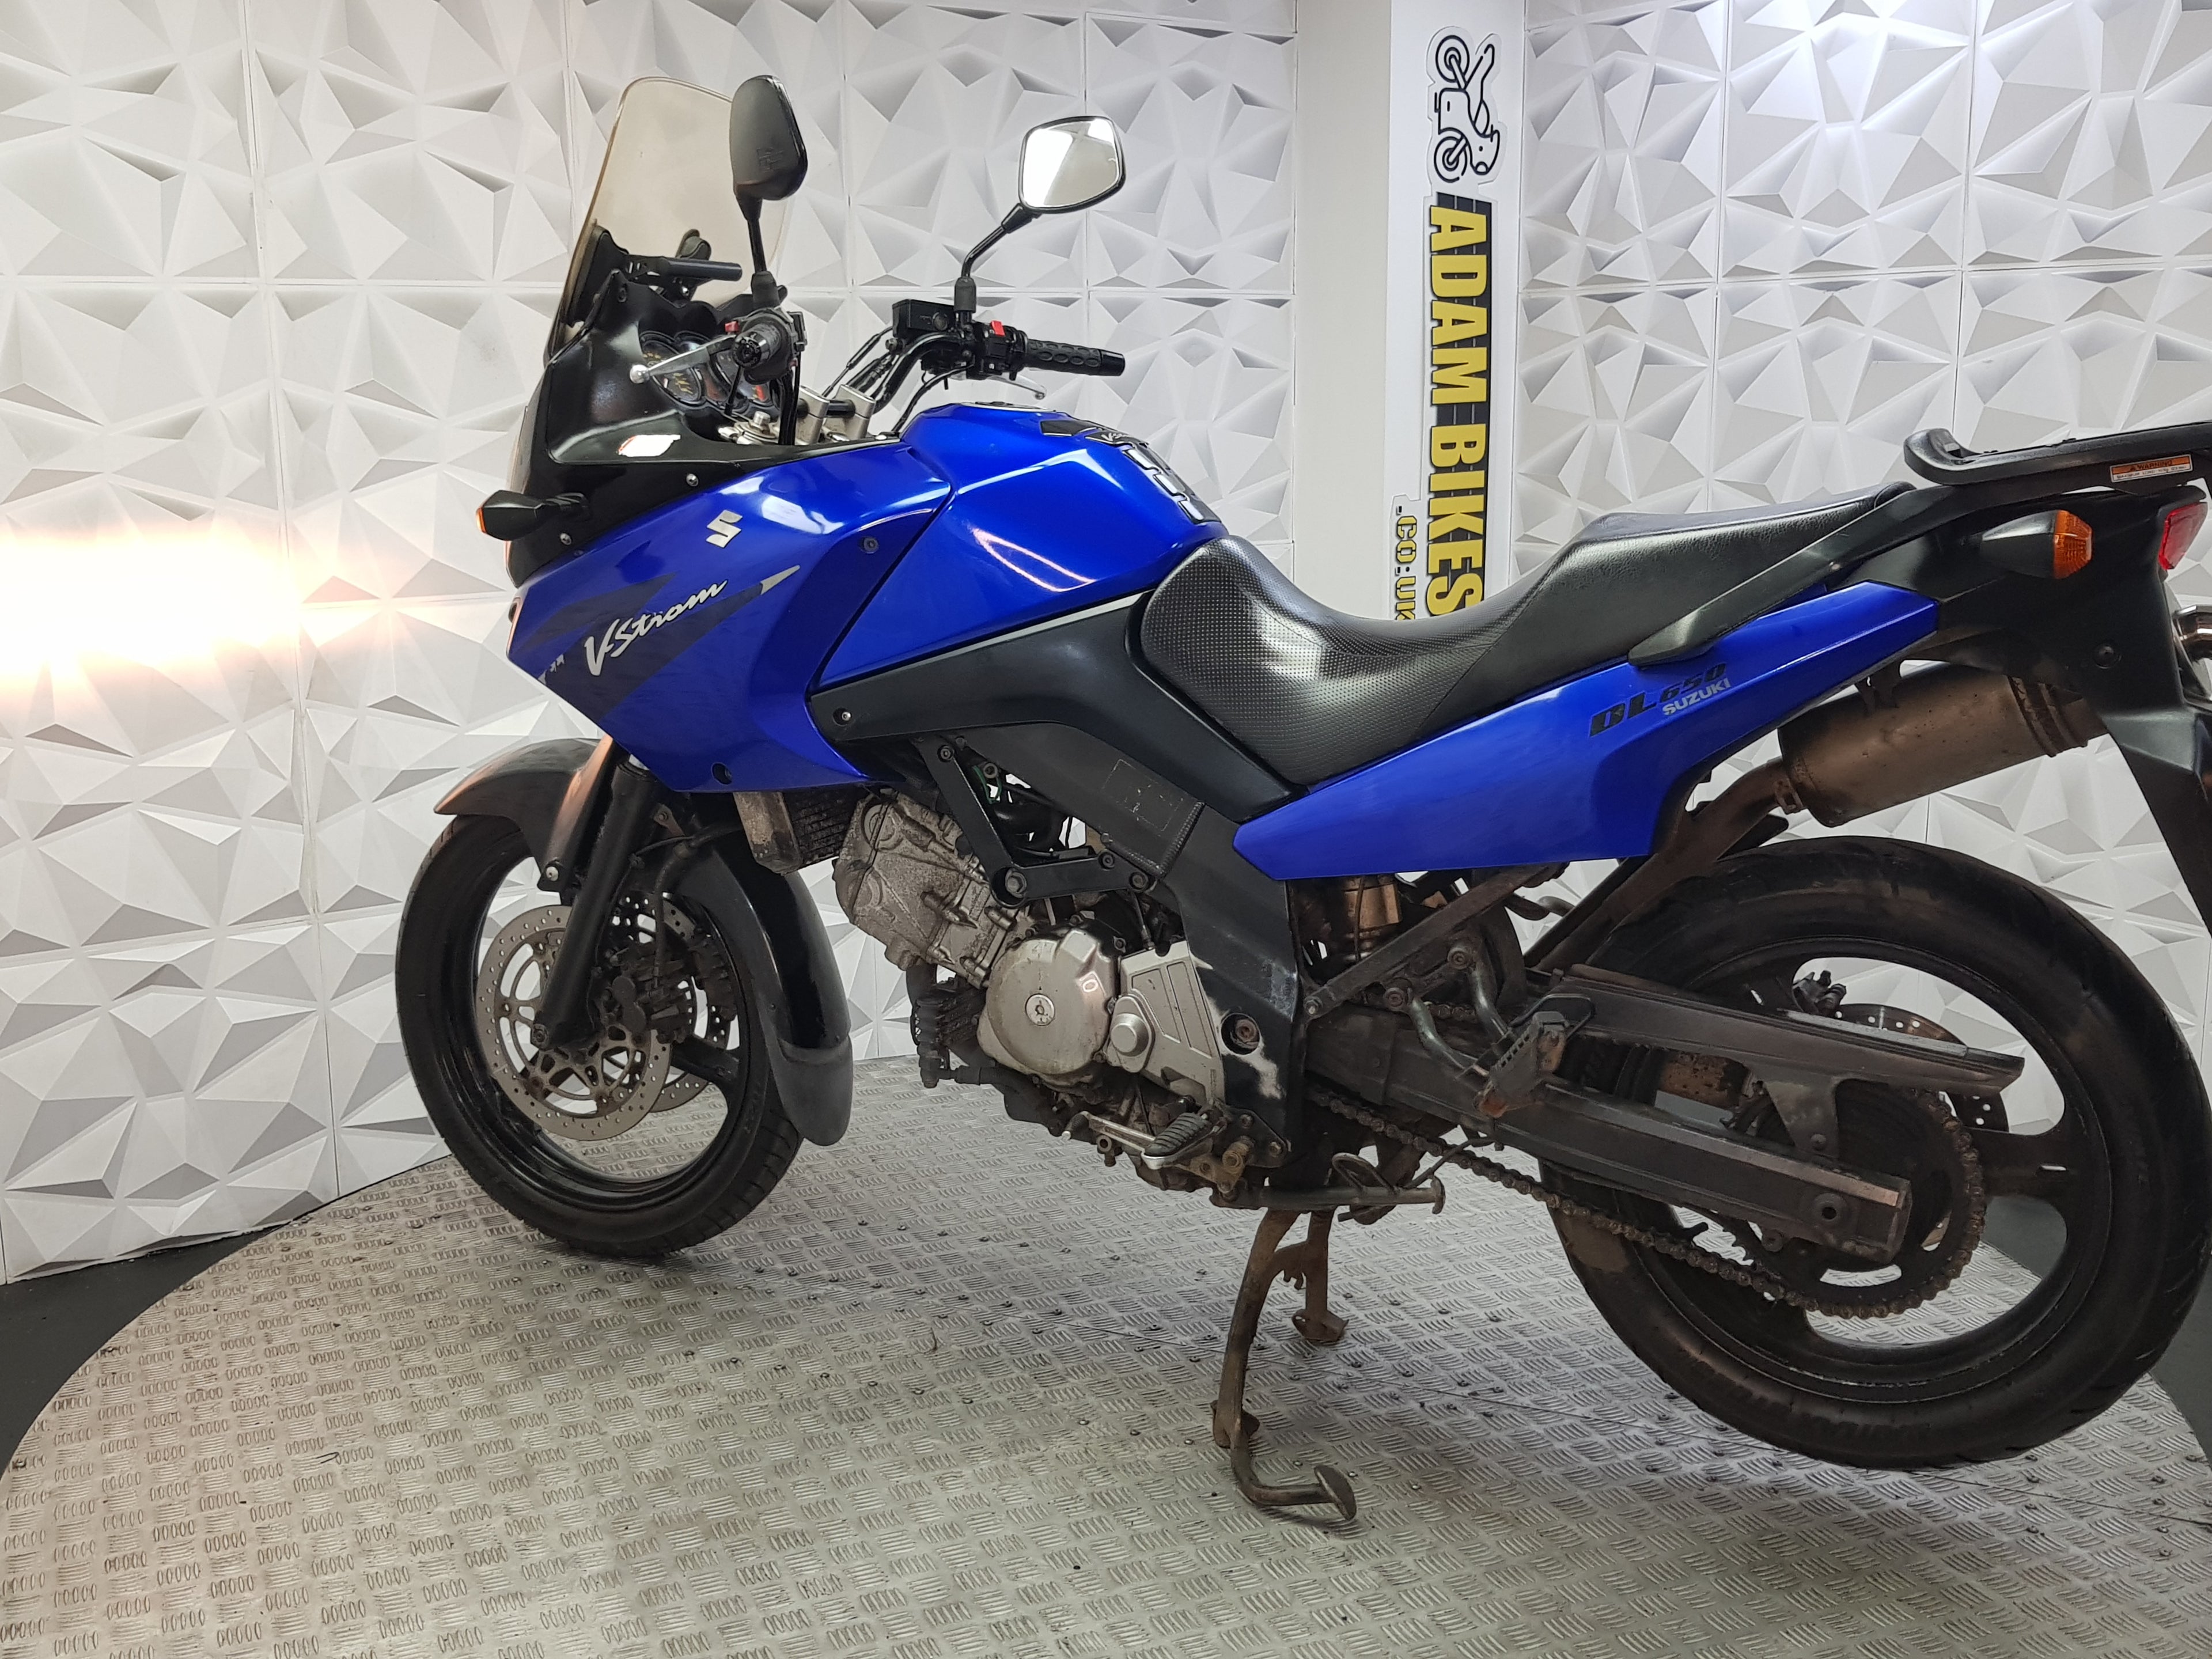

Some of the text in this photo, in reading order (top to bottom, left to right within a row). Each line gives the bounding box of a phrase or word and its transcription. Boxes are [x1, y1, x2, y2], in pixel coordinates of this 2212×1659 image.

[1425, 204, 1488, 617] ADAM BIKES
[2137, 460, 2173, 471] WARNING
[1662, 677, 1731, 716] SUZUKI
